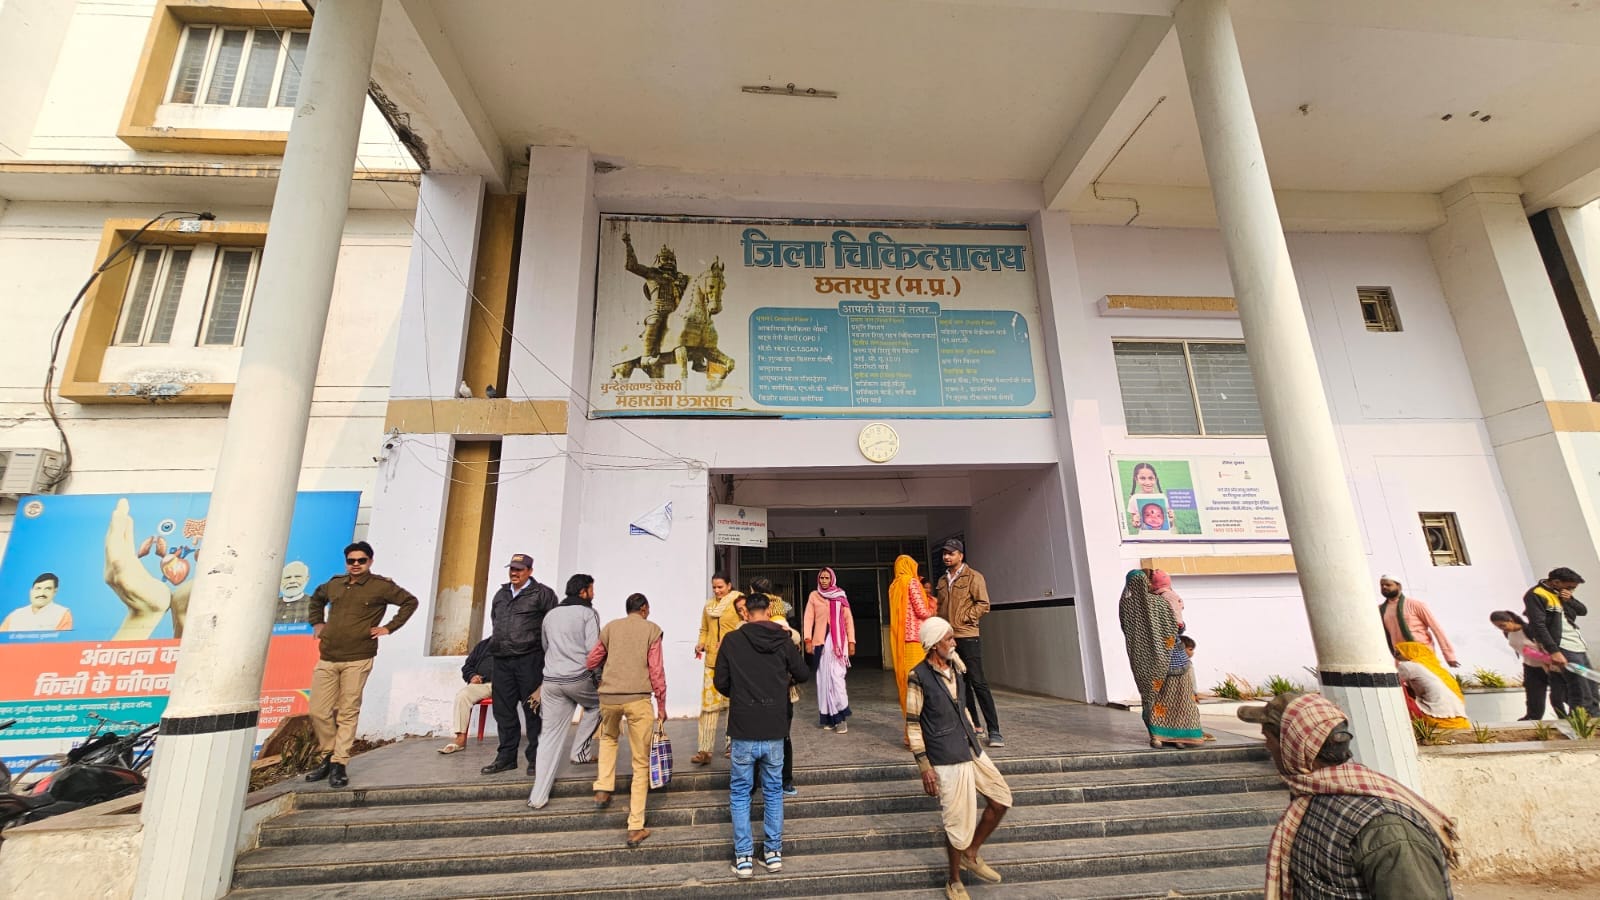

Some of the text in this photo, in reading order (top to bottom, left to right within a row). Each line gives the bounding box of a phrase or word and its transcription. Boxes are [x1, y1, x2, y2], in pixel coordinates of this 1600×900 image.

[741, 229, 1027, 271] जिला चिकित्सालय
[814, 275, 961, 299] छतरपुर (म.प्र.)
[843, 304, 874, 313] आपकी
[877, 305, 895, 313] सेवा
[898, 304, 906, 313] में
[655, 380, 682, 391] केसरी
[616, 395, 733, 408] महाराजा छत्रसाल
[80, 644, 158, 667] अंगदान
[34, 672, 90, 696] किसी
[91, 671, 114, 694] के
